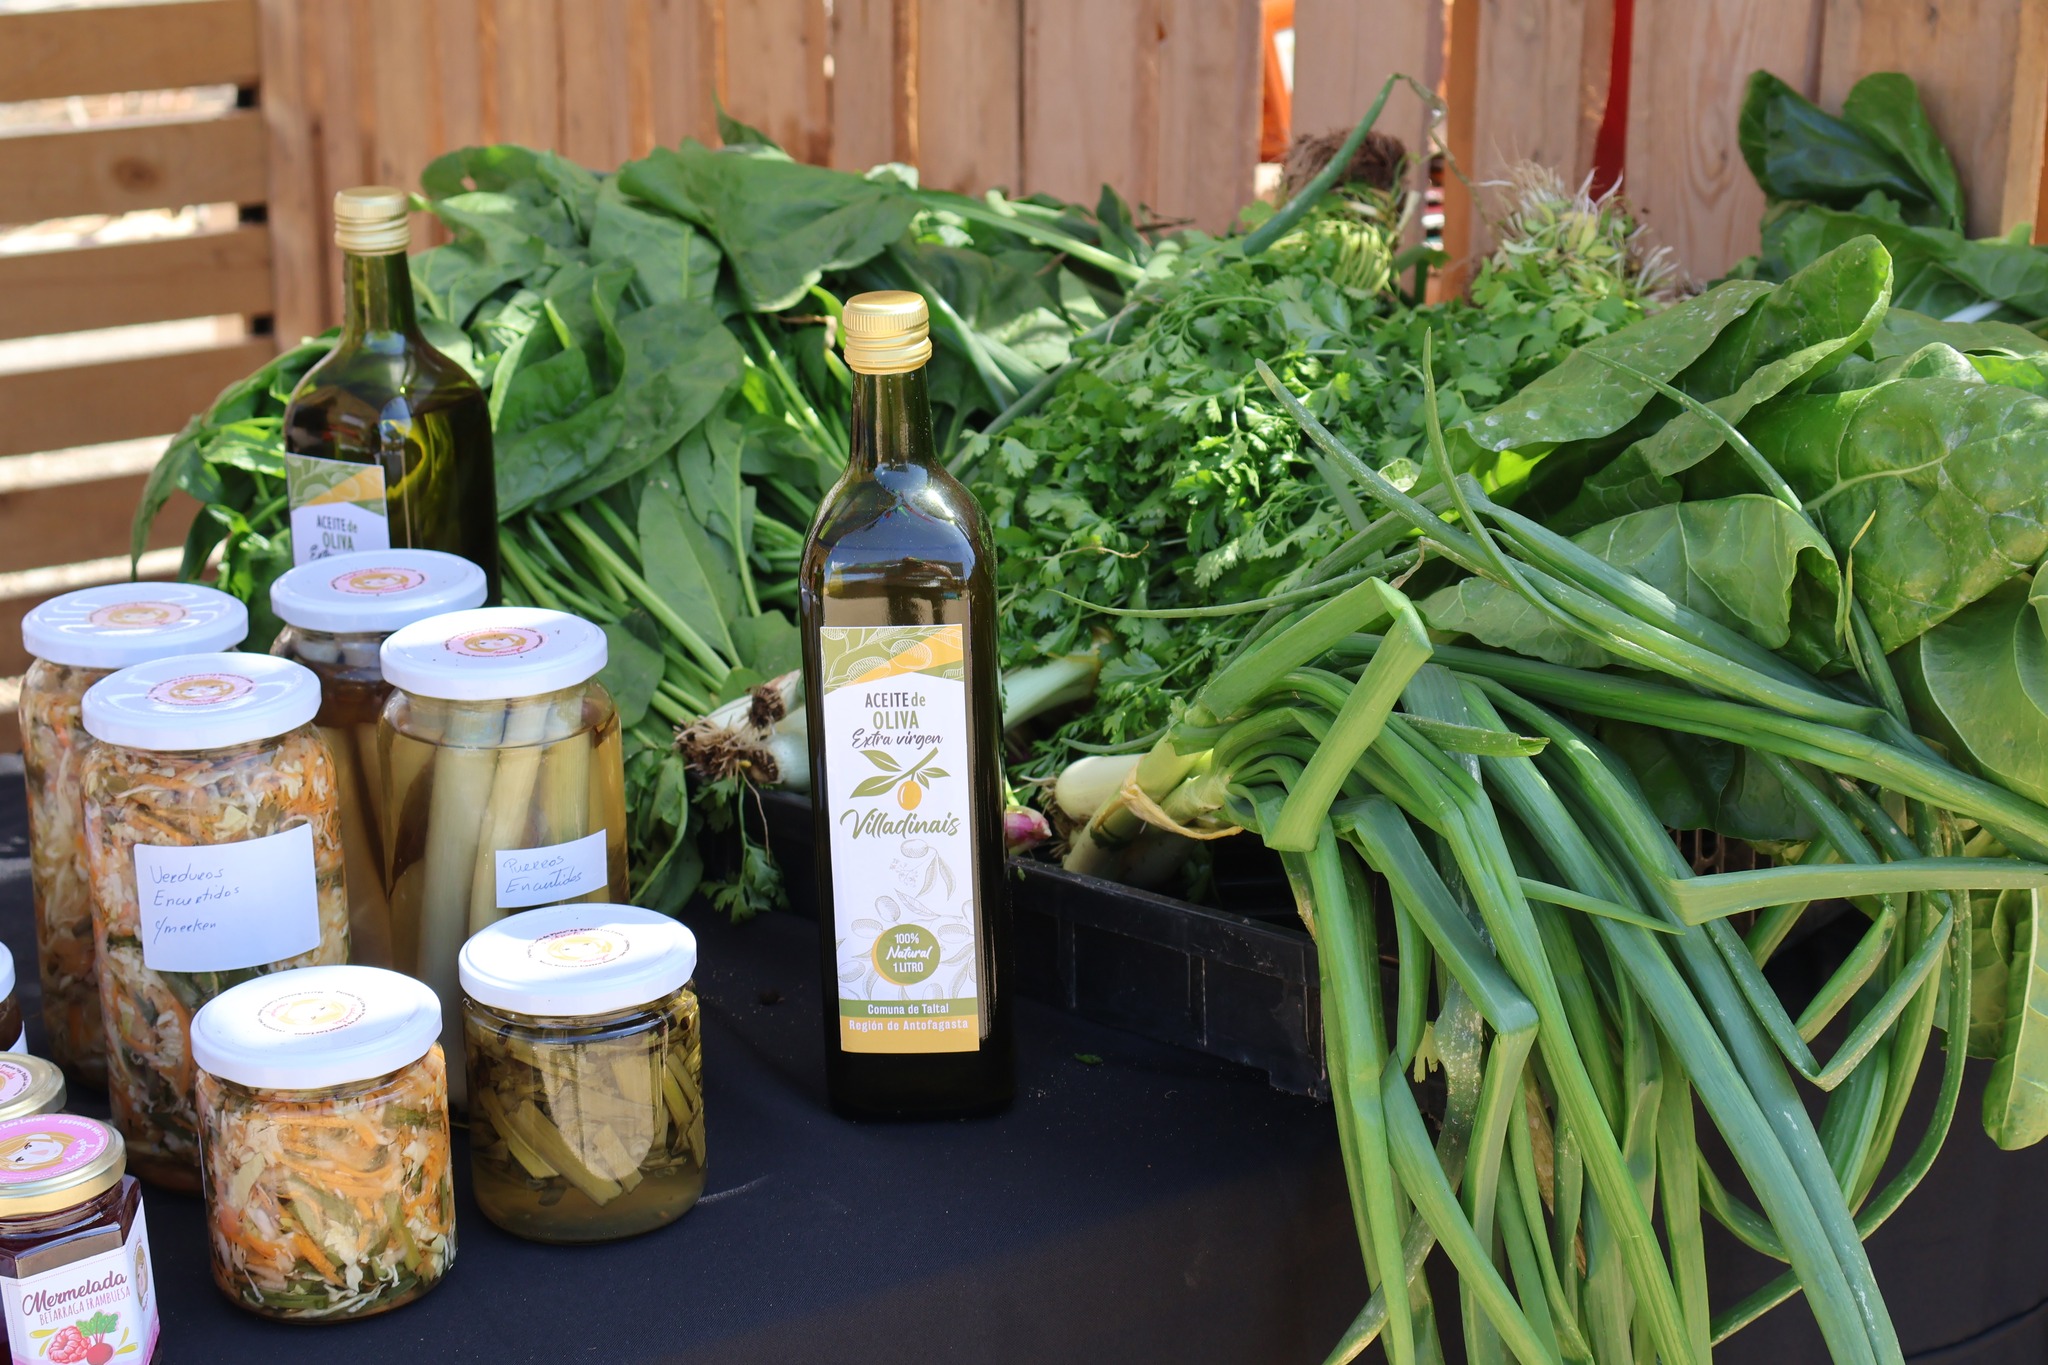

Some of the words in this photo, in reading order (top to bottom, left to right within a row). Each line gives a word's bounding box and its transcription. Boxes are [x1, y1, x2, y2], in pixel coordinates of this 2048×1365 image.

[316, 514, 346, 532] ACEITE
[347, 519, 358, 534] de
[322, 532, 355, 552] OLIVA
[865, 692, 909, 708] ACEITE
[911, 692, 926, 707] de
[873, 710, 919, 730] OLIVA
[851, 728, 893, 749] Extra
[896, 730, 944, 751] virgen
[840, 808, 961, 840] Villadinais
[153, 885, 240, 907] Encurtidos
[894, 932, 920, 945] 100%
[885, 945, 933, 961] Natural
[892, 962, 898, 974] 1
[899, 961, 924, 973] LITRO
[867, 1003, 905, 1015] Comuna
[907, 1003, 919, 1015] de
[921, 1002, 950, 1014] Taltal
[849, 1019, 883, 1032] Región
[887, 1019, 899, 1031] de
[903, 1018, 969, 1032] Antofagasta
[22, 1270, 128, 1316] Mermelada
[39, 1302, 85, 1326] BETARRAGA
[86, 1285, 131, 1311] FRAMBUESA
